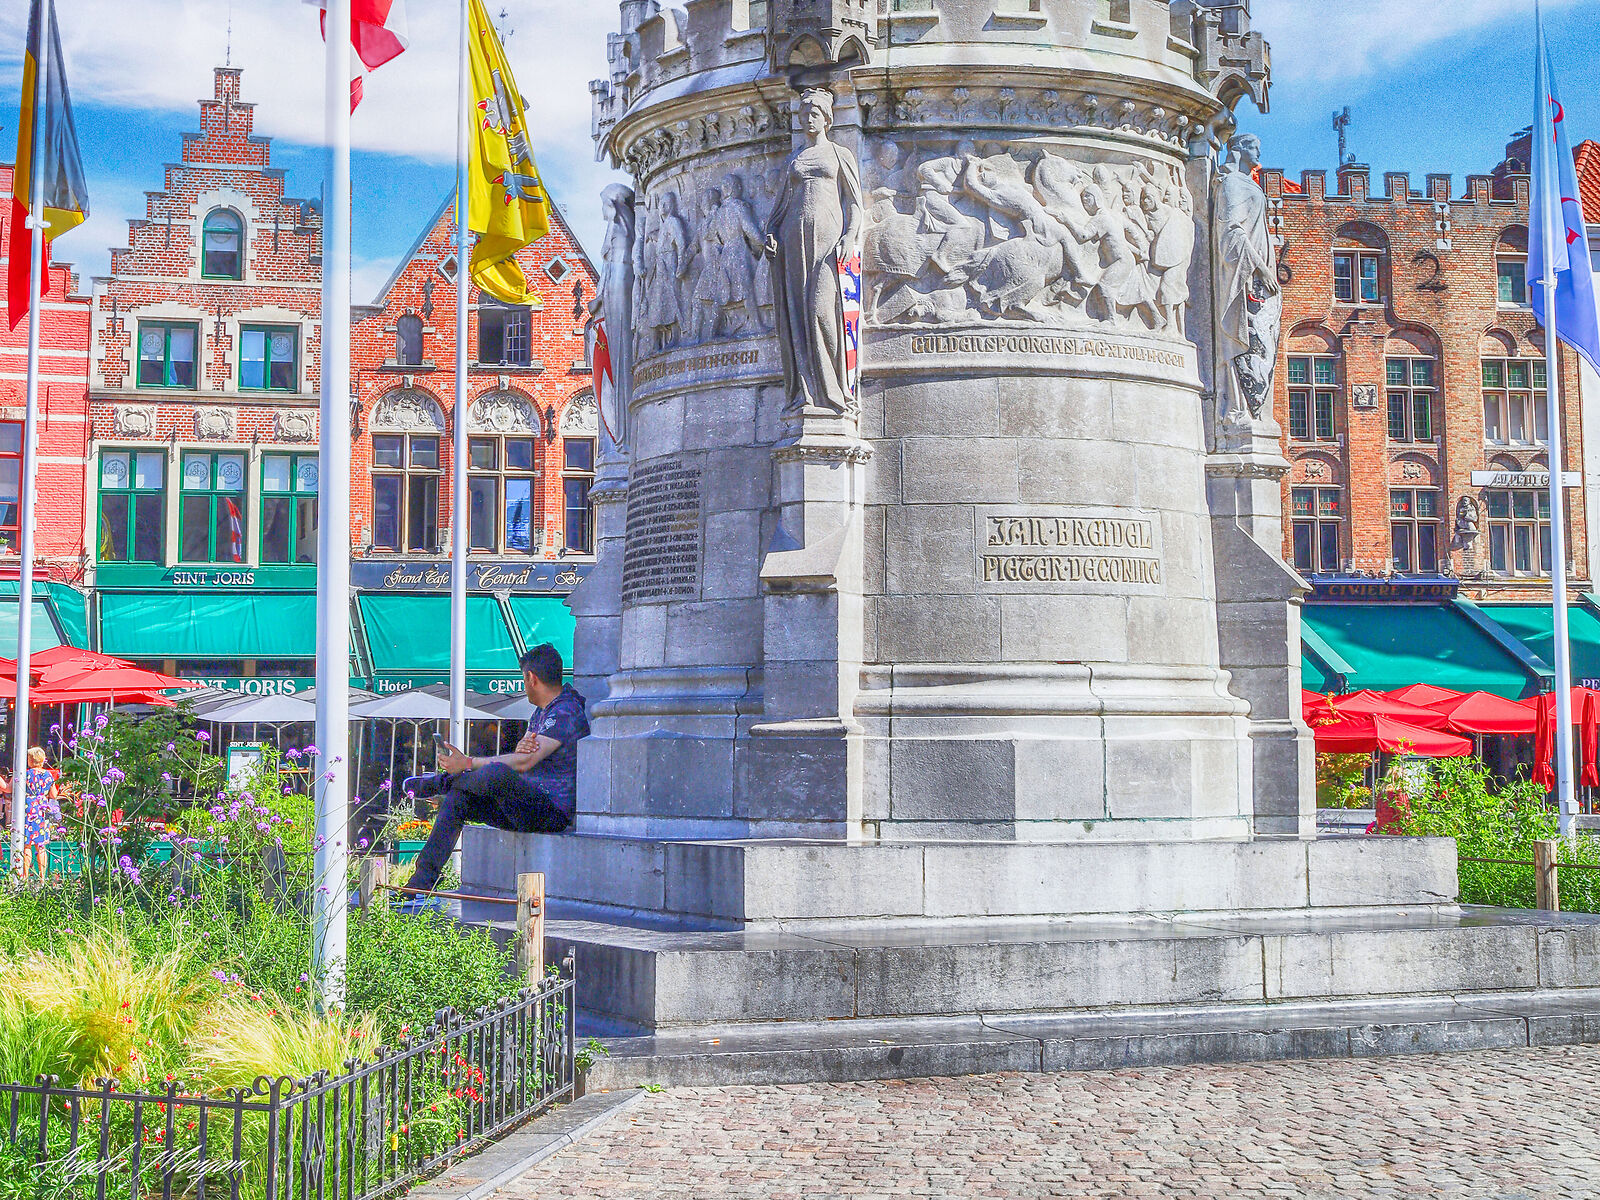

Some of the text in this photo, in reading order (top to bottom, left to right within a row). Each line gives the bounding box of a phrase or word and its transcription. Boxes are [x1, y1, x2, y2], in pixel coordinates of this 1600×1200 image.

[987, 517, 1152, 549] JAN BREIDEL
[173, 572, 255, 585] SINT JORIS
[384, 570, 424, 587] Grand
[475, 564, 531, 589] Central
[981, 556, 1066, 582] PIETER
[378, 679, 412, 692] Hotel
